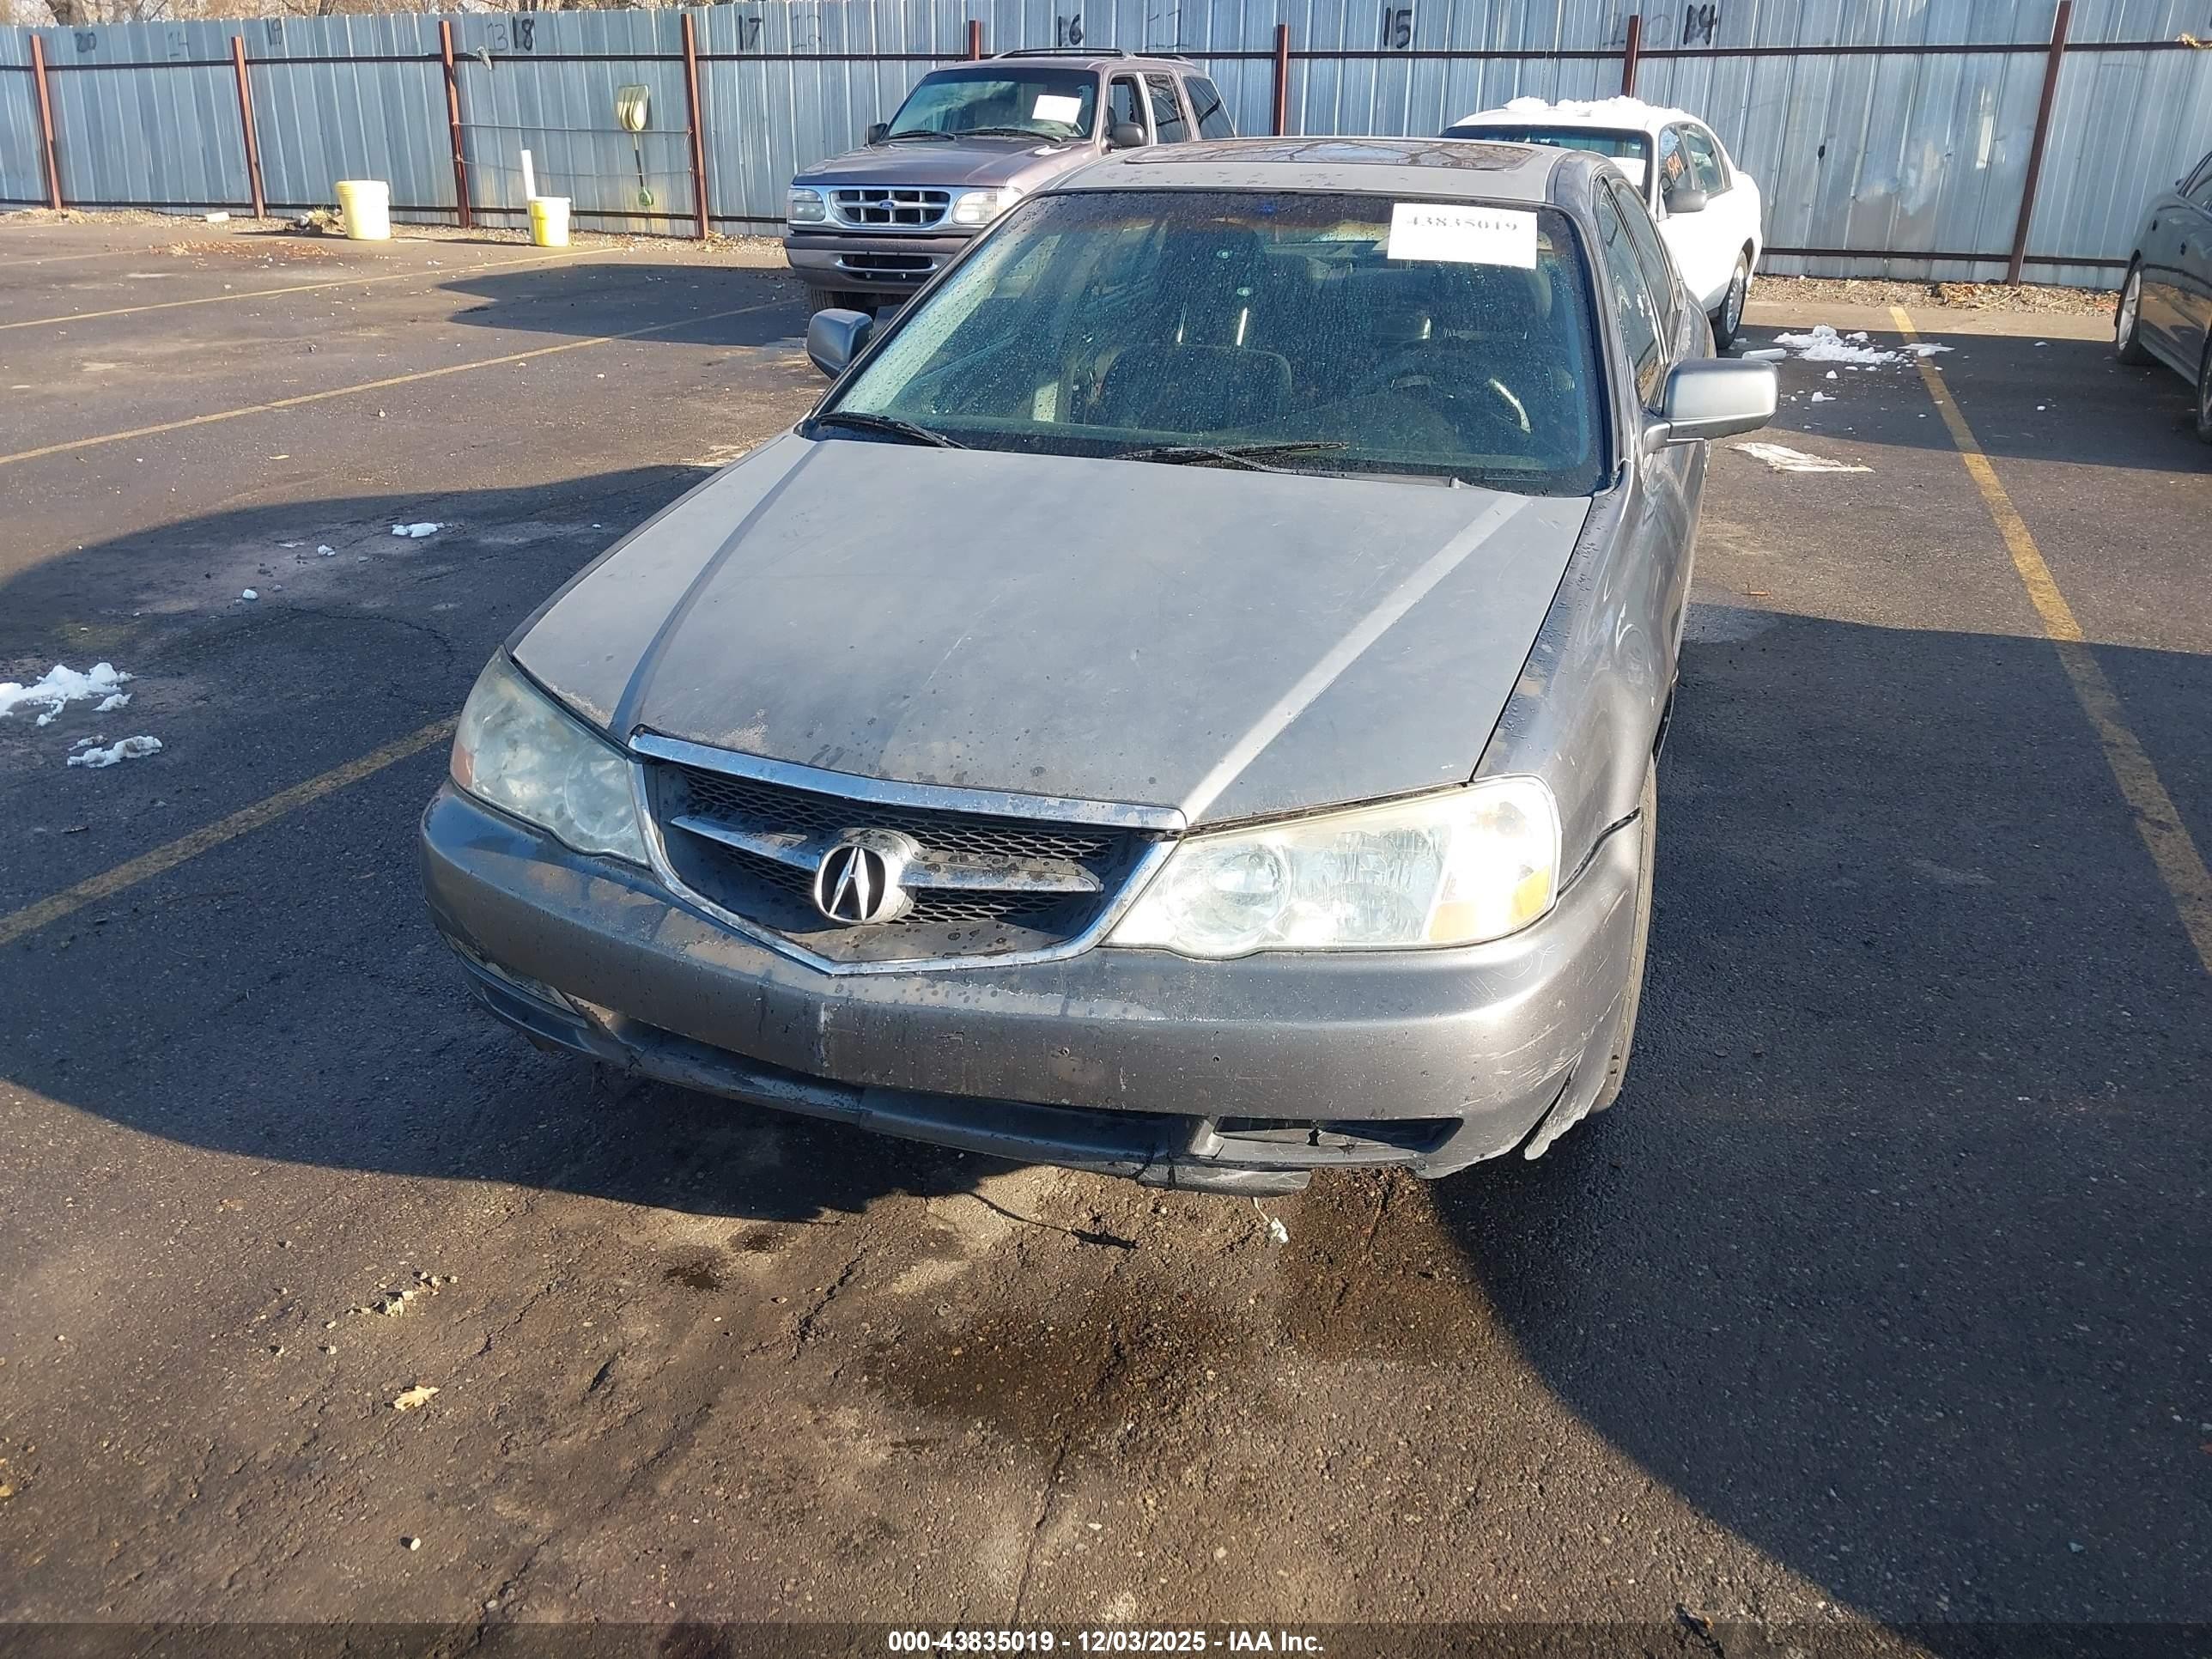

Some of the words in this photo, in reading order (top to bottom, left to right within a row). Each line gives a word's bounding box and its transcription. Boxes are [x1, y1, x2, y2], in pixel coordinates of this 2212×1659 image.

[487, 23, 509, 51] 13
[512, 15, 534, 52] 18
[738, 14, 763, 51] 17
[1057, 13, 1084, 47] 16
[1383, 7, 1412, 49] 15
[1683, 3, 1717, 46] 14
